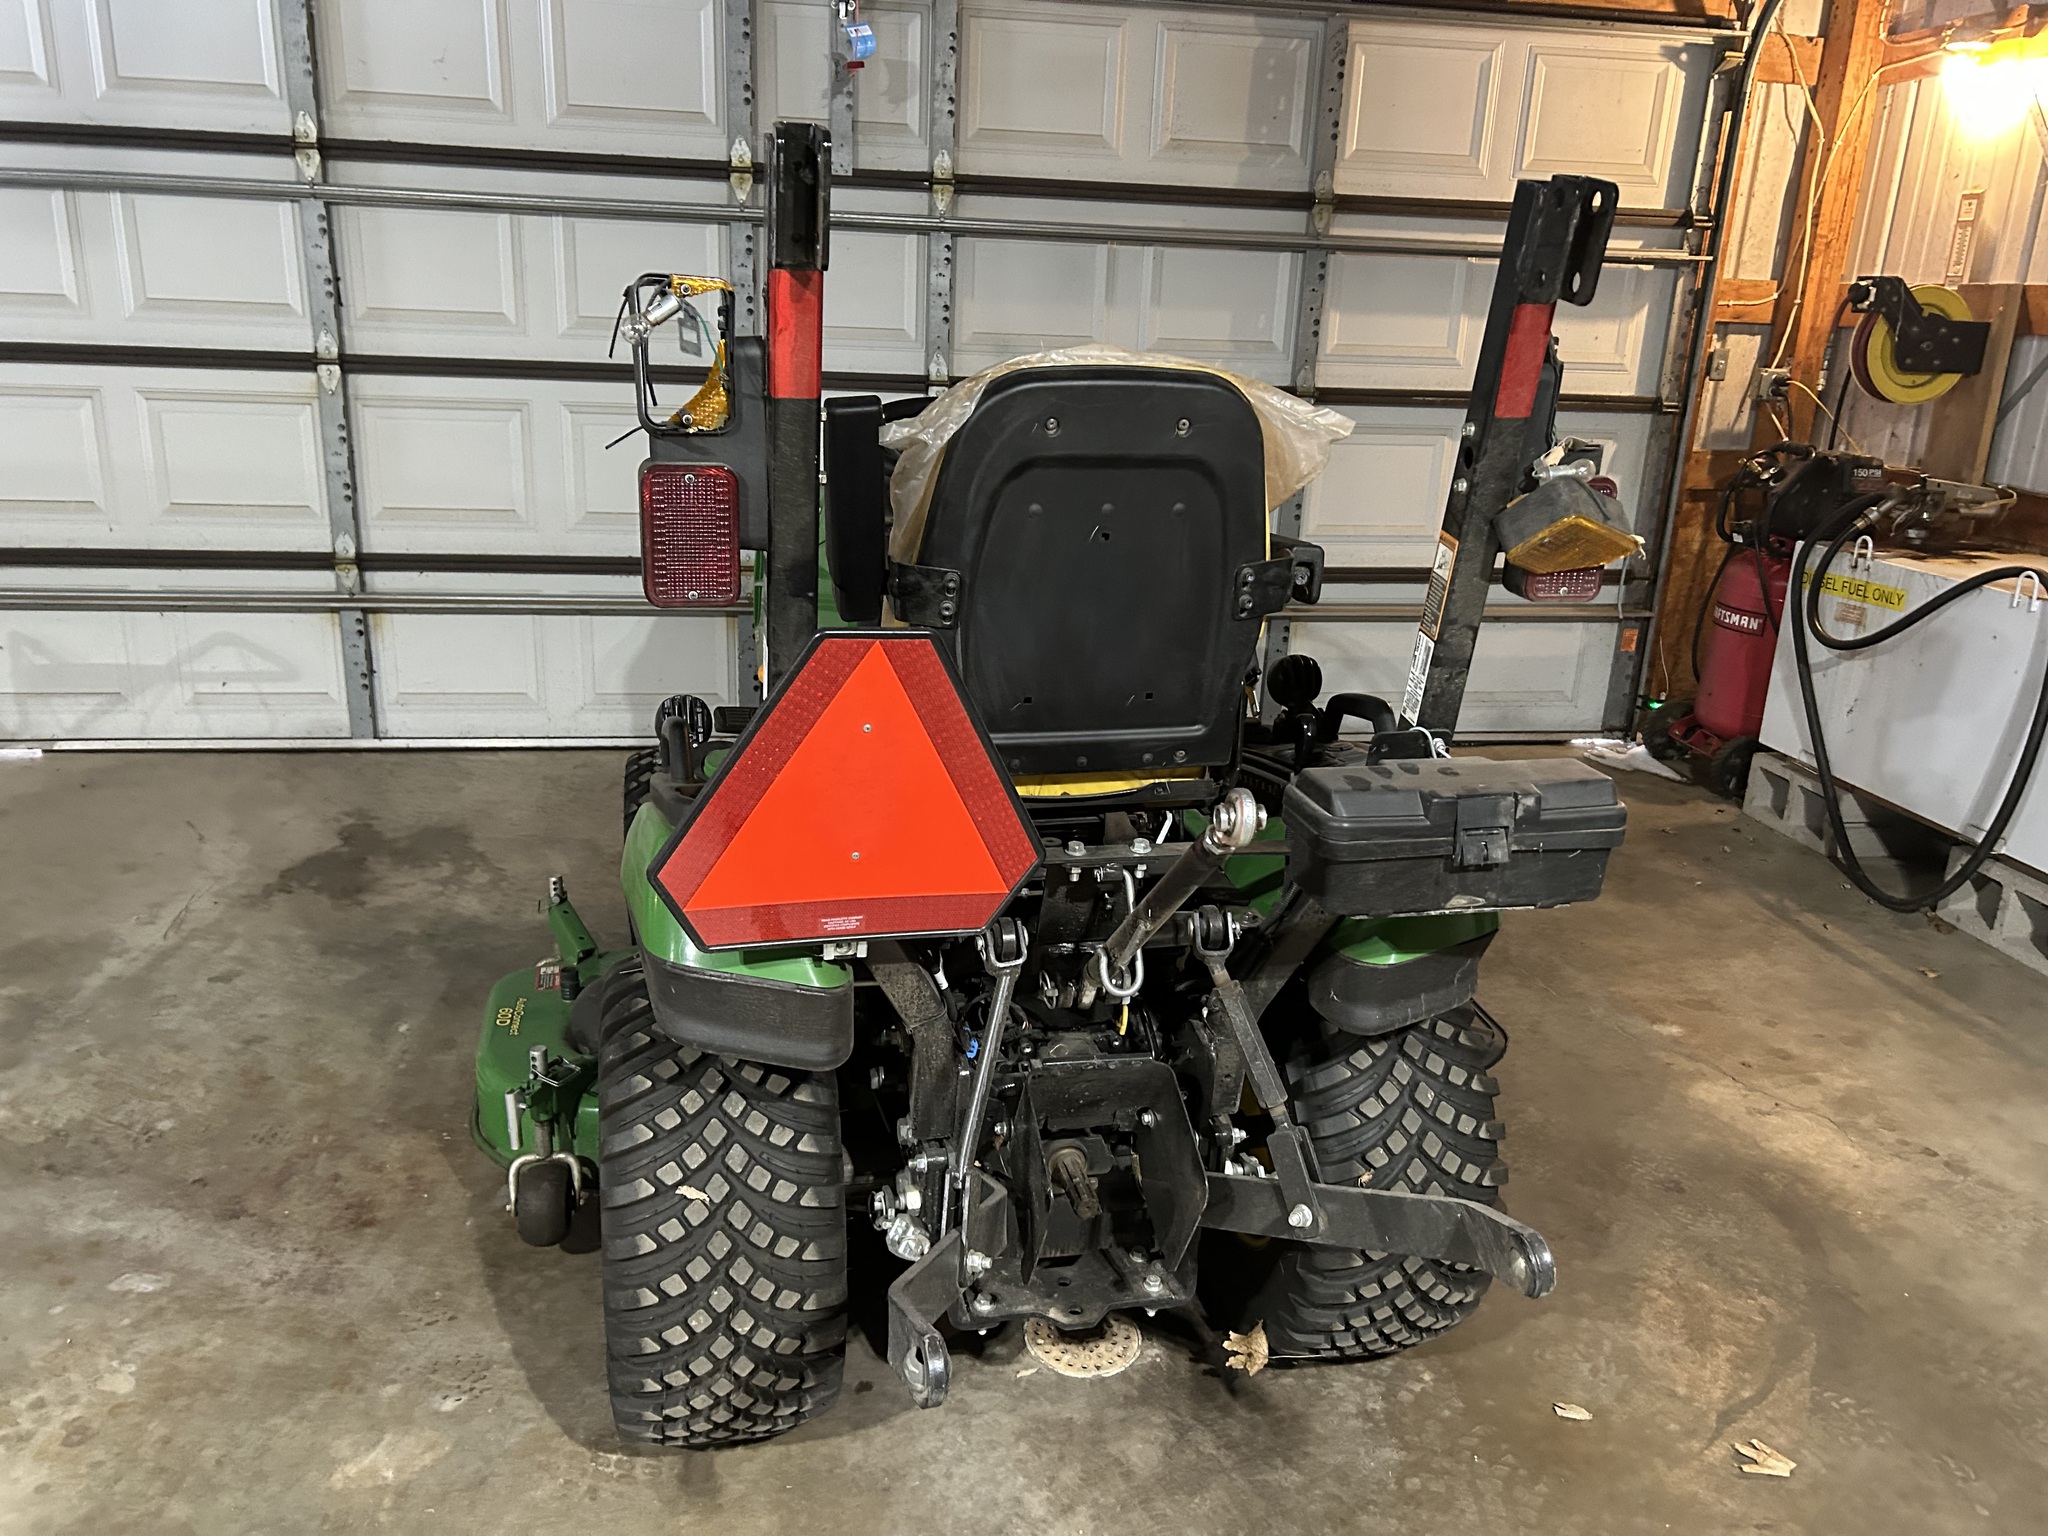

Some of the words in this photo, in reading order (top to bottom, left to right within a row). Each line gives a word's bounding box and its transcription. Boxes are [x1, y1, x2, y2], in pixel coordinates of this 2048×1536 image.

[1853, 468, 1868, 477] 150
[1801, 571, 1838, 592] DISEL
[1841, 580, 1869, 599] FUEL
[1872, 587, 1905, 606] ONLY
[496, 1007, 513, 1026] 60D
[510, 997, 527, 1035] AutoConnect
